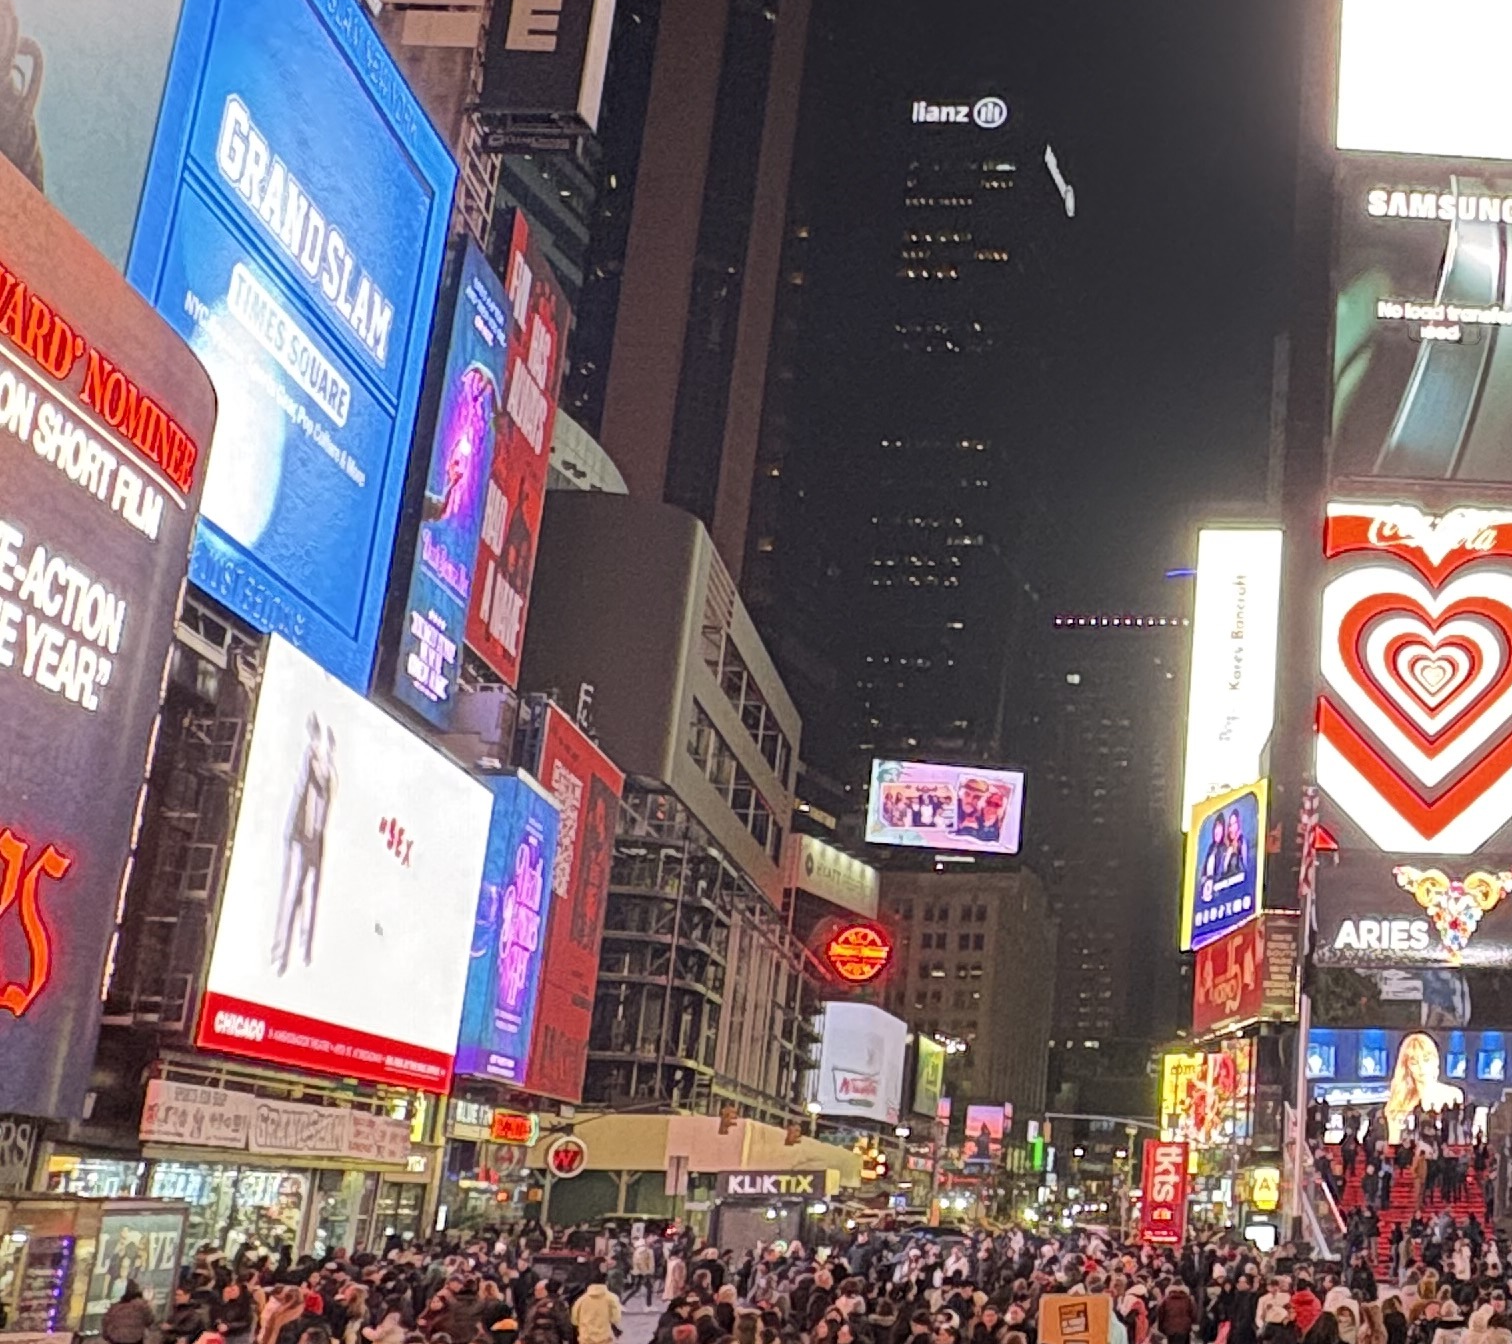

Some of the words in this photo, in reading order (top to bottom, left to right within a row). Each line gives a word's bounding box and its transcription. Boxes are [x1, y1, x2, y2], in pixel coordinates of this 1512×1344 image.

[216, 92, 321, 284] GRAND
[320, 242, 394, 370] SLAM
[235, 272, 286, 352] TIMES
[286, 333, 348, 419] SQUARE
[33, 400, 118, 502] SHORT
[111, 464, 164, 541] FILM
[1334, 920, 1430, 950] ARIES
[213, 1010, 266, 1043] CHICAGO
[727, 1174, 814, 1194] KLIKTIX
[1153, 1145, 1180, 1204] tkts
